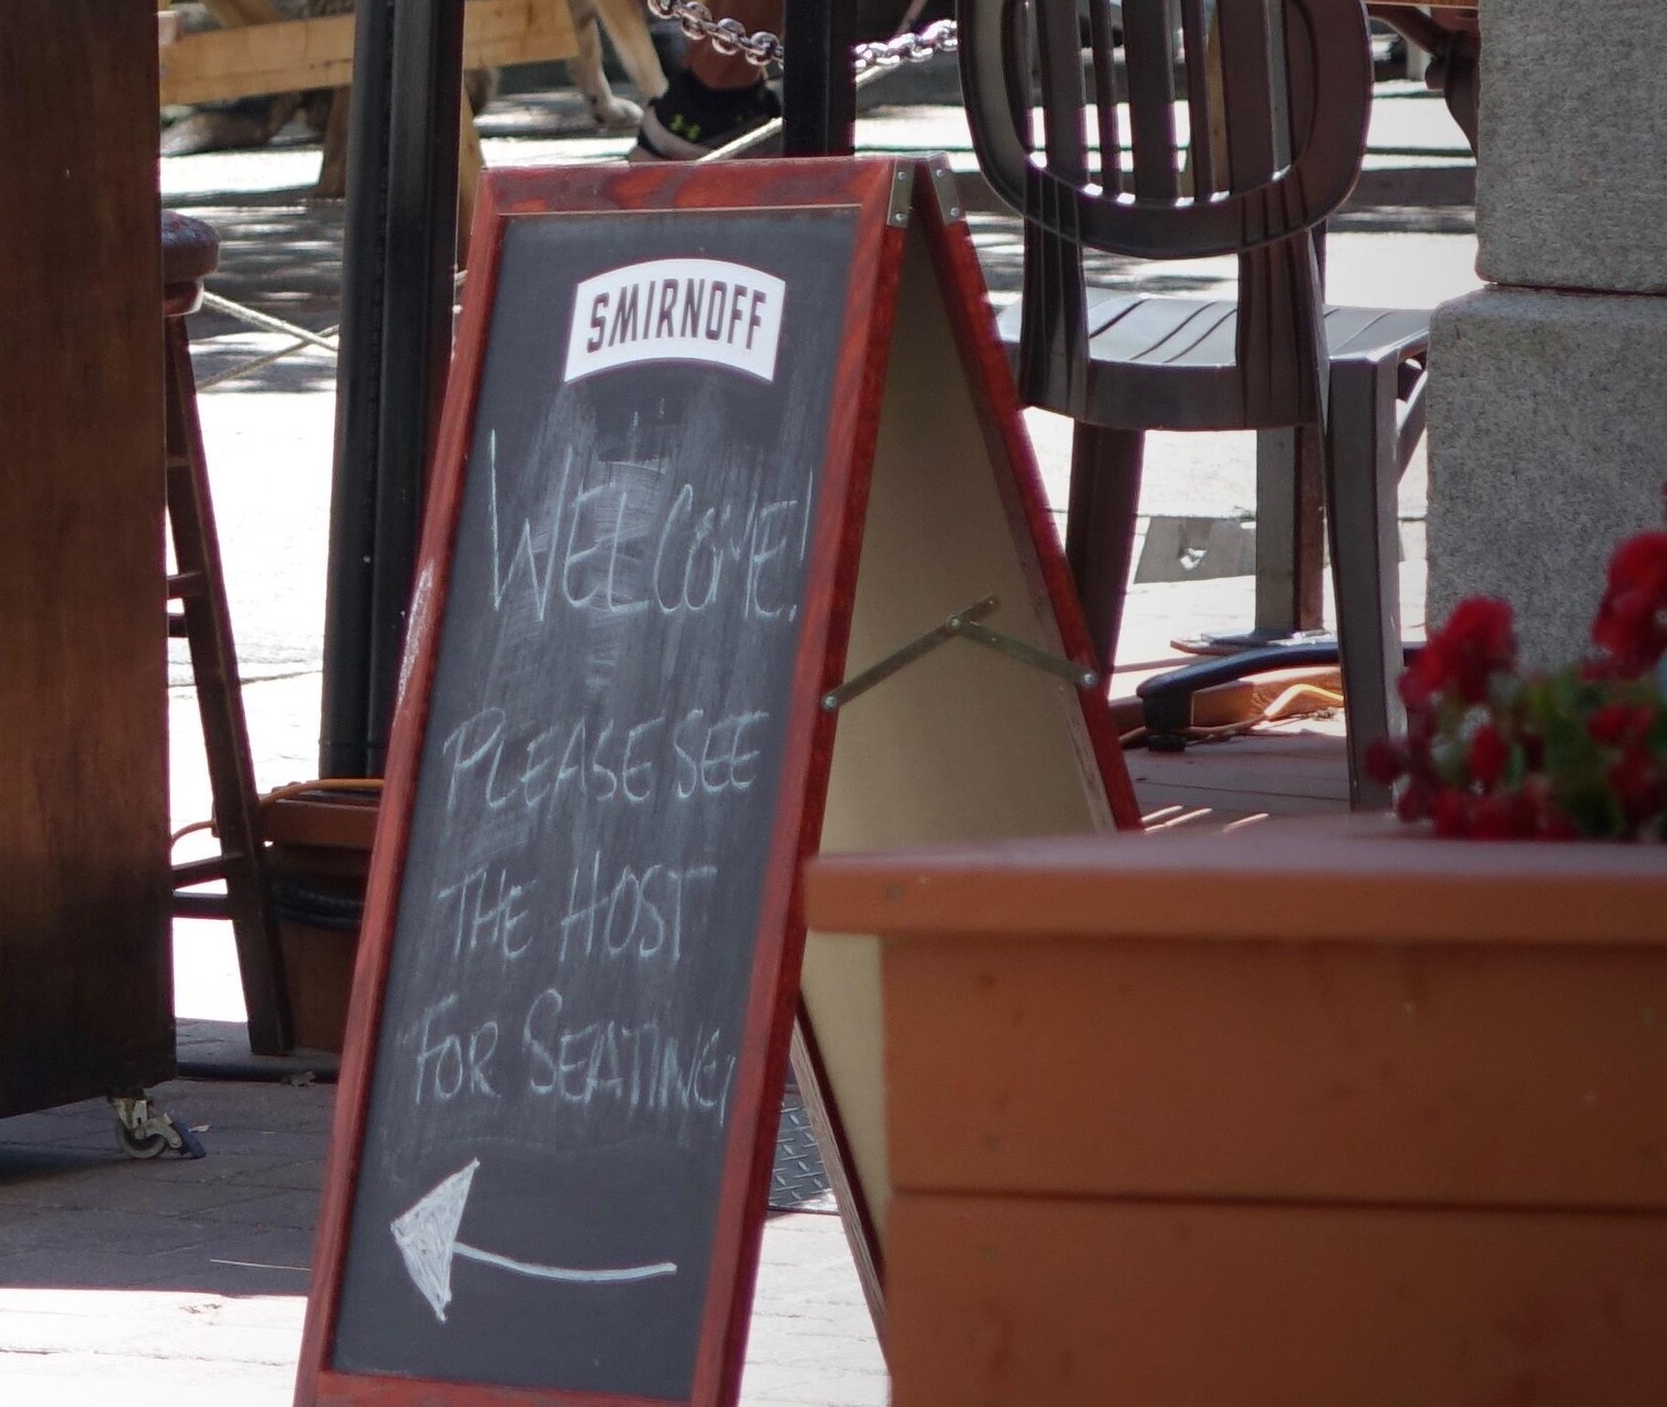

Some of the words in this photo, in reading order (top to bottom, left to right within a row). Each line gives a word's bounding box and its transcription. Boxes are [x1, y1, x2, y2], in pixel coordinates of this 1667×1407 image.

[586, 277, 767, 354] SMIRNOFF
[489, 428, 814, 624] WELCOME!
[443, 706, 666, 826] PLEASE
[673, 707, 770, 800] SEE
[437, 863, 541, 962] THE
[560, 850, 719, 964] HOST
[416, 993, 501, 1107] FOR
[523, 987, 737, 1129] SEATING
